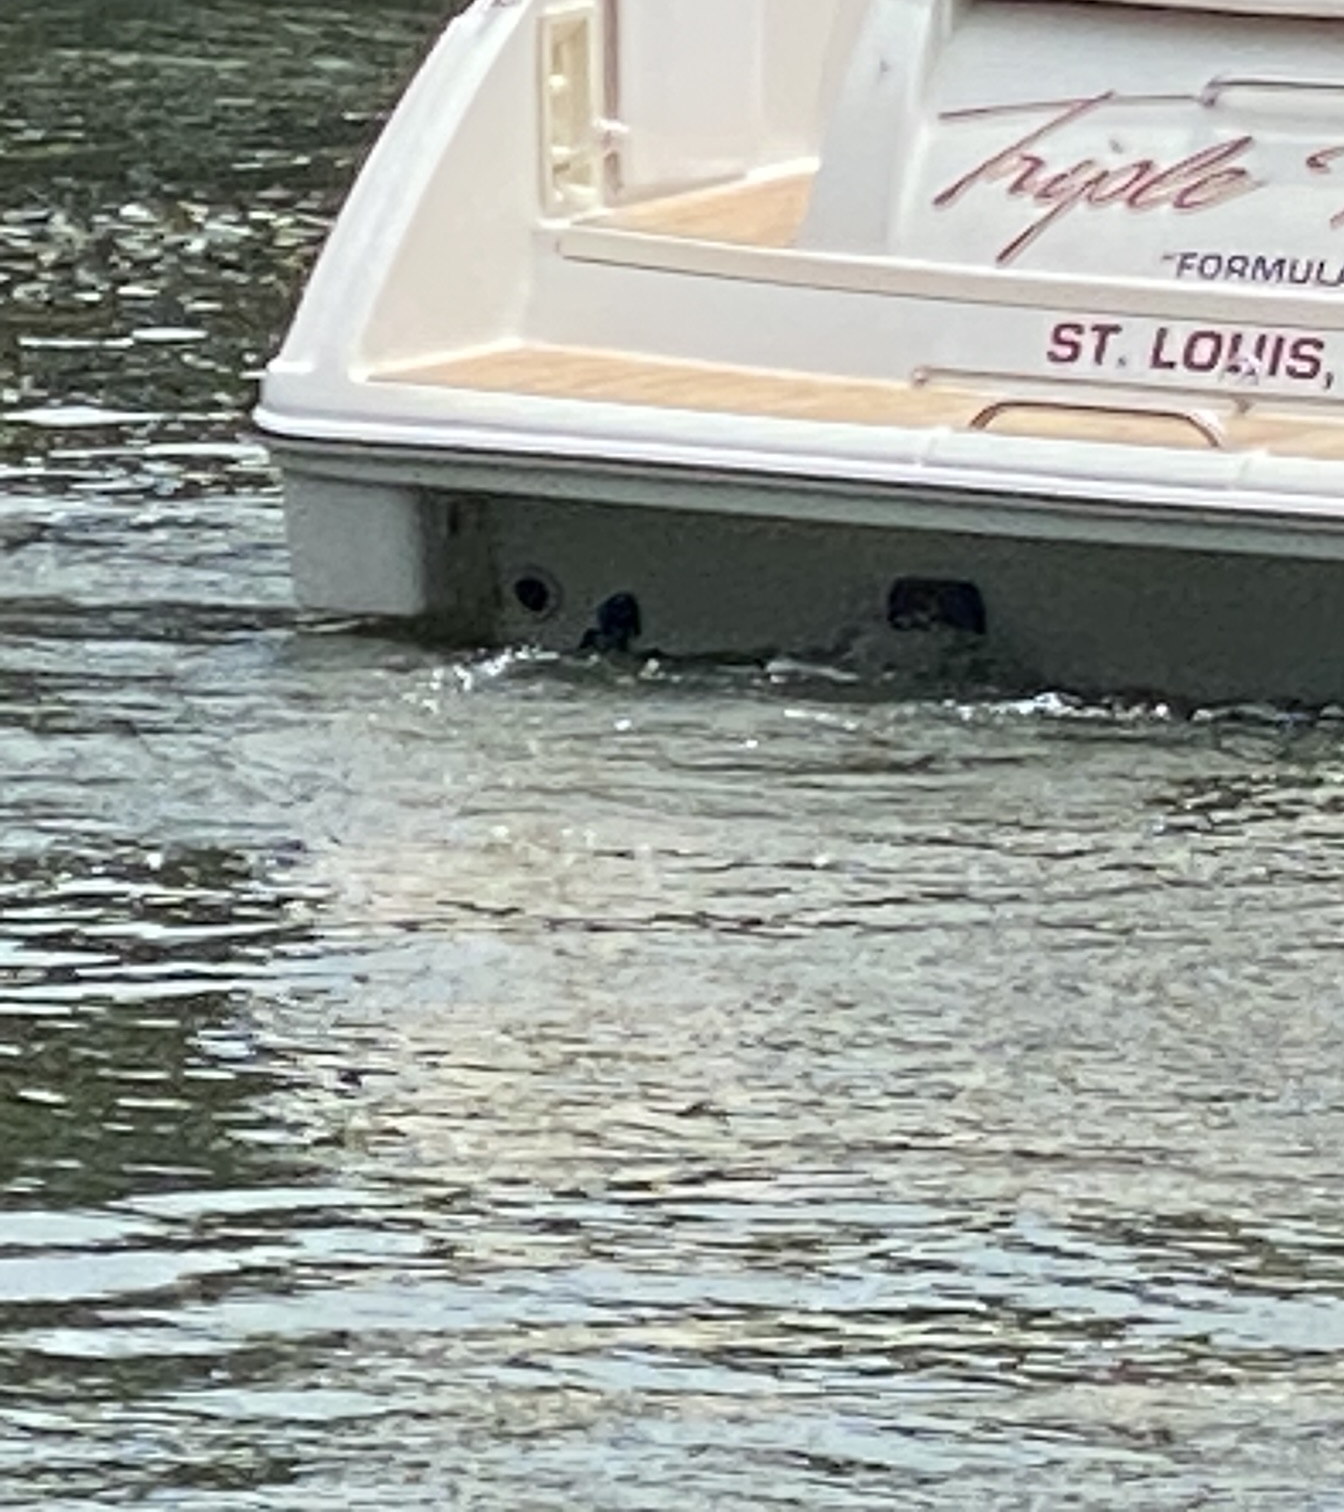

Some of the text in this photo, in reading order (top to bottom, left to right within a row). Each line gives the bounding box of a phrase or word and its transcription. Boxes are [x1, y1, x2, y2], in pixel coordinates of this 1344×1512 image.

[933, 91, 1266, 265] Triple
[1046, 321, 1129, 368] ST.
[1149, 327, 1337, 391] LOUIS,
